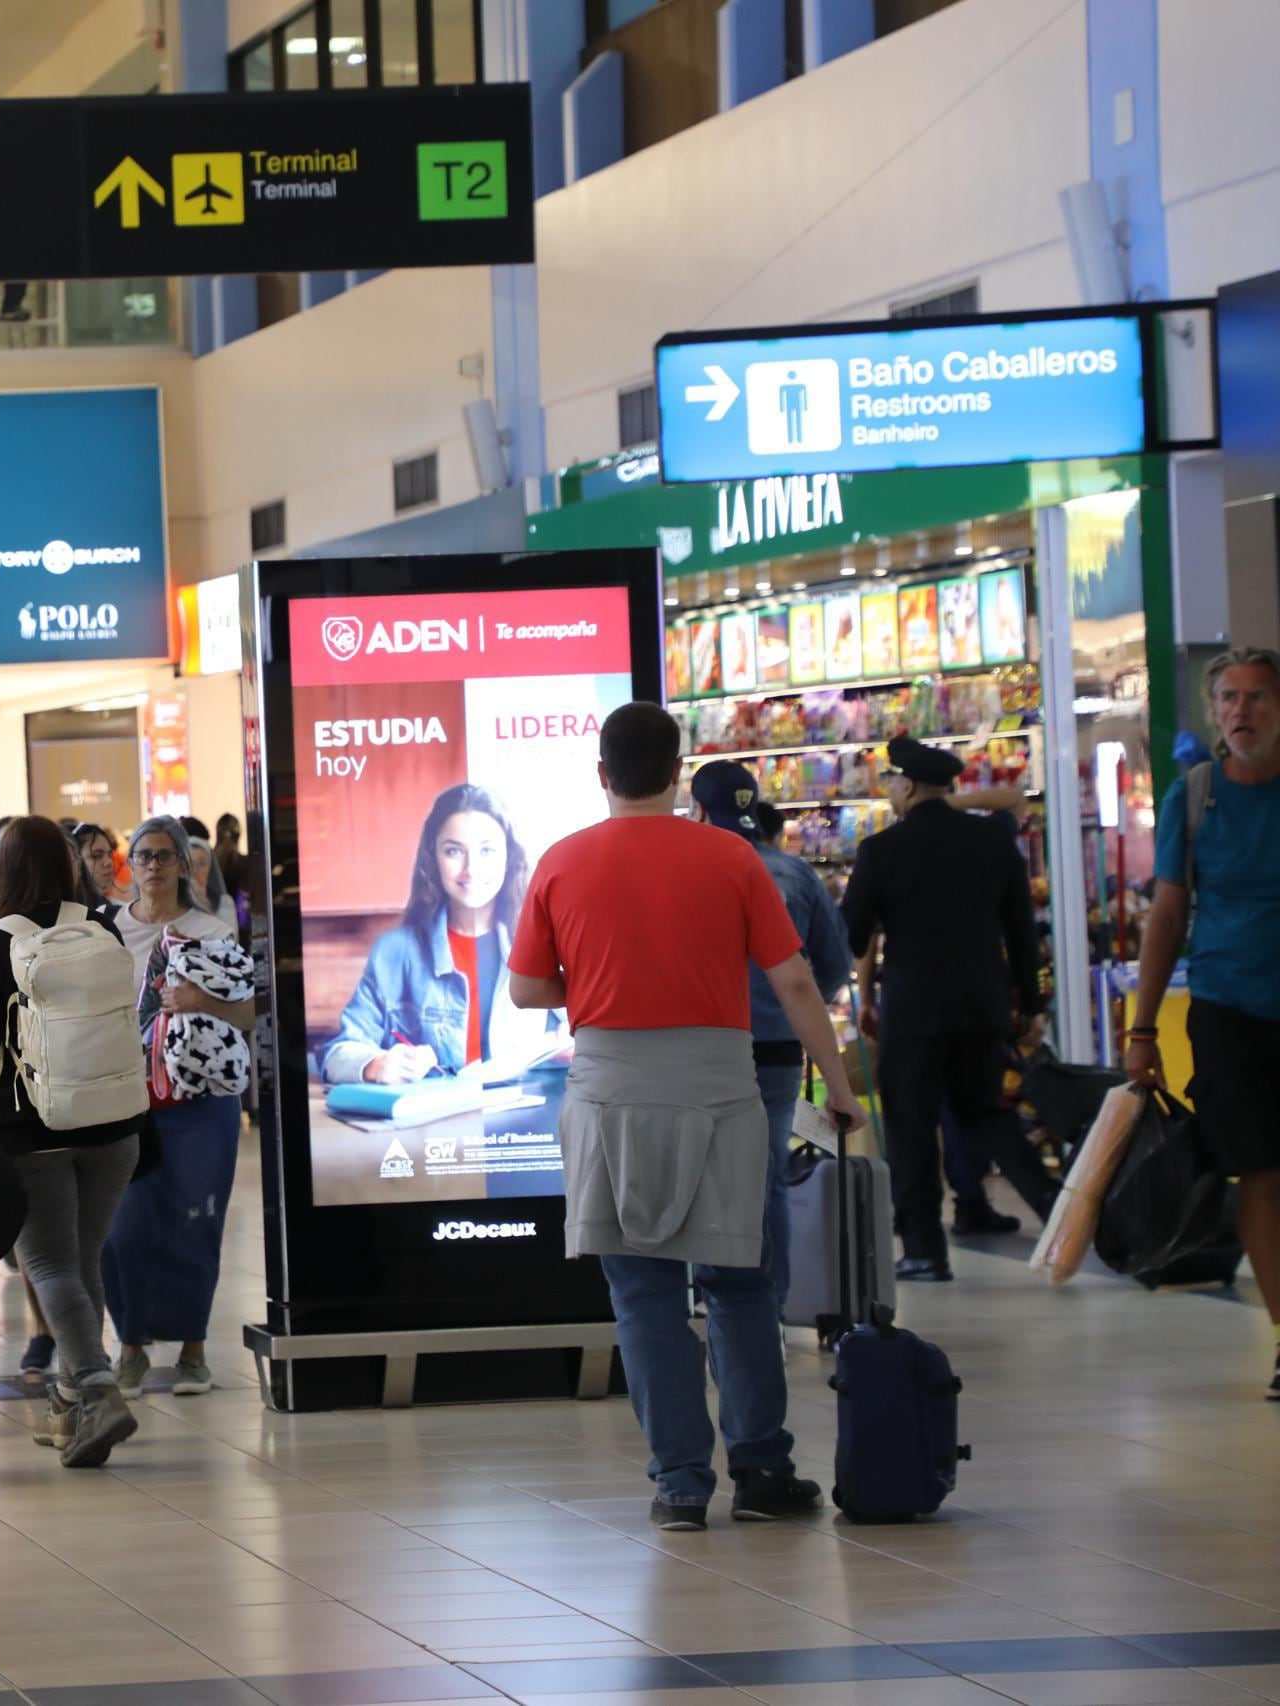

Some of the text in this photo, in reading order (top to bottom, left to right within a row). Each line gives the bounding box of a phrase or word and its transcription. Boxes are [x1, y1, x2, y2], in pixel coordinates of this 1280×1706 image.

[250, 148, 357, 174] Terminal
[251, 178, 337, 199] Terminal
[433, 161, 492, 201] T2
[849, 345, 1117, 388] Baño Caballeros
[851, 389, 992, 419] Restrooms
[852, 422, 939, 445] Banheiro
[39, 603, 119, 631] POLO
[365, 618, 598, 654] ADEN Te acompaña
[314, 713, 600, 748] ESTUDIA LIDERA
[316, 749, 368, 780] hoy
[424, 1142, 457, 1159] GW
[432, 1220, 537, 1240] JCDecaux
